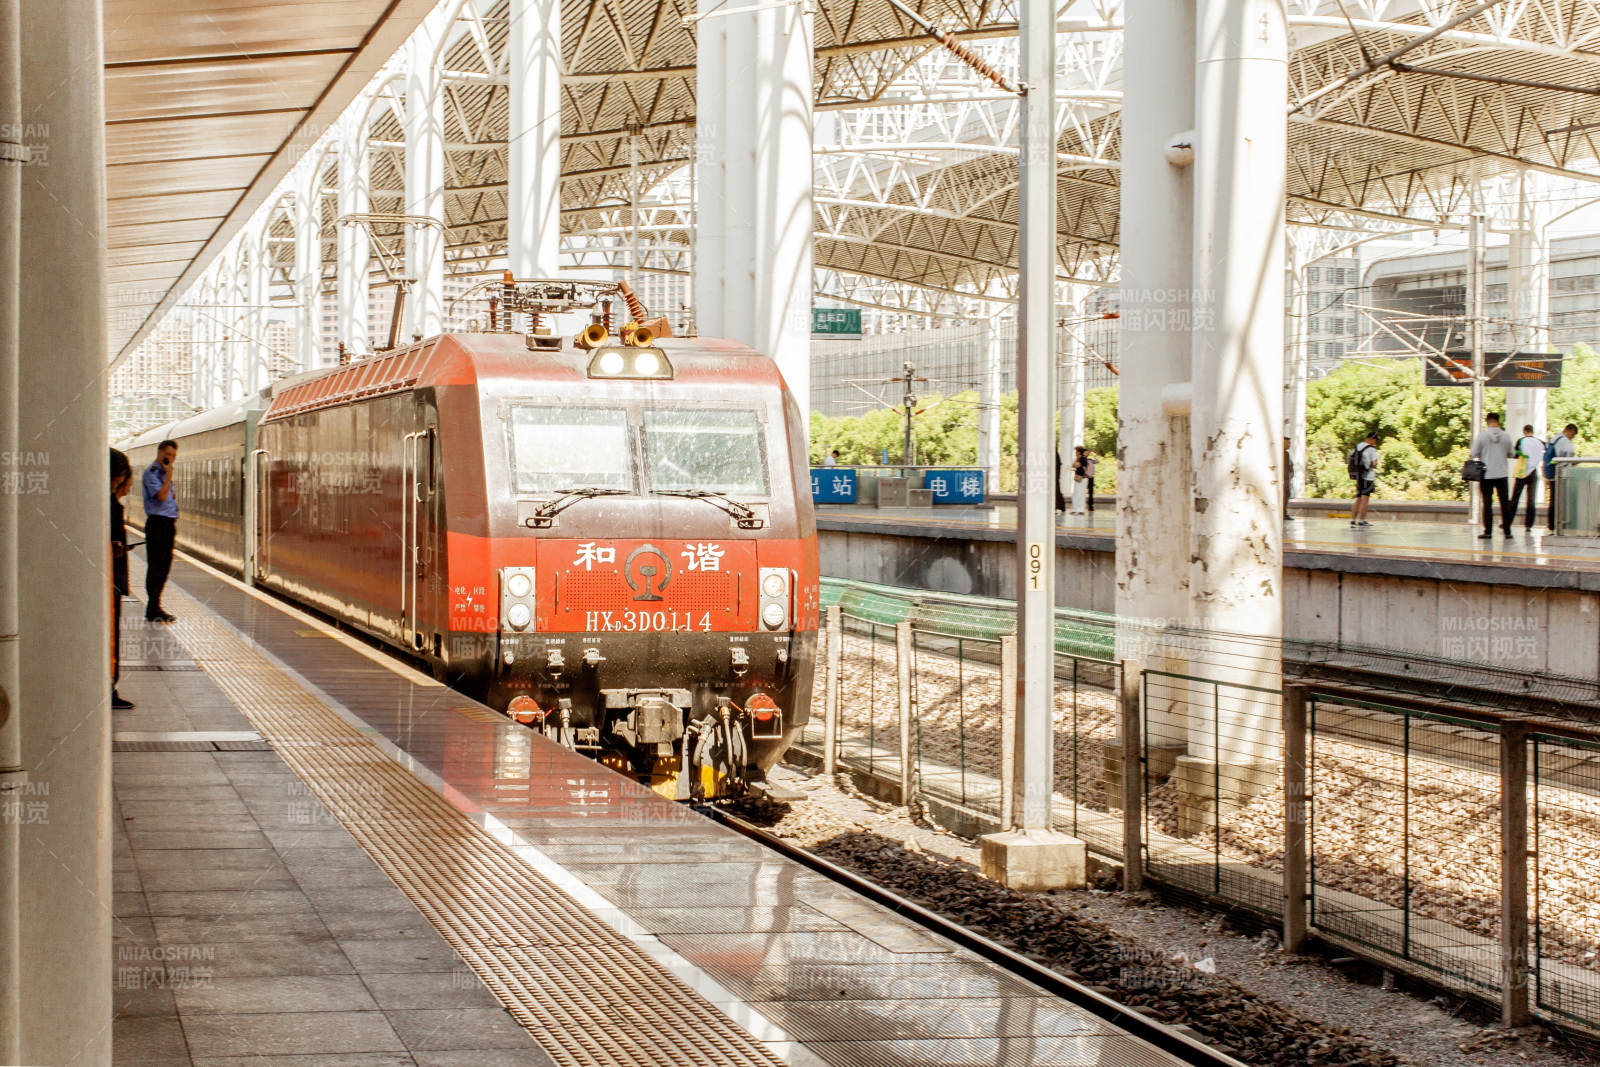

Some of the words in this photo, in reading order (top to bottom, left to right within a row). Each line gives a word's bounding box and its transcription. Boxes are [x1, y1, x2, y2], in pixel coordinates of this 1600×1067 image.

[930, 476, 980, 497] 电梯
[573, 542, 615, 571] 和
[681, 543, 725, 572] 谐
[1030, 544, 1041, 589] 091
